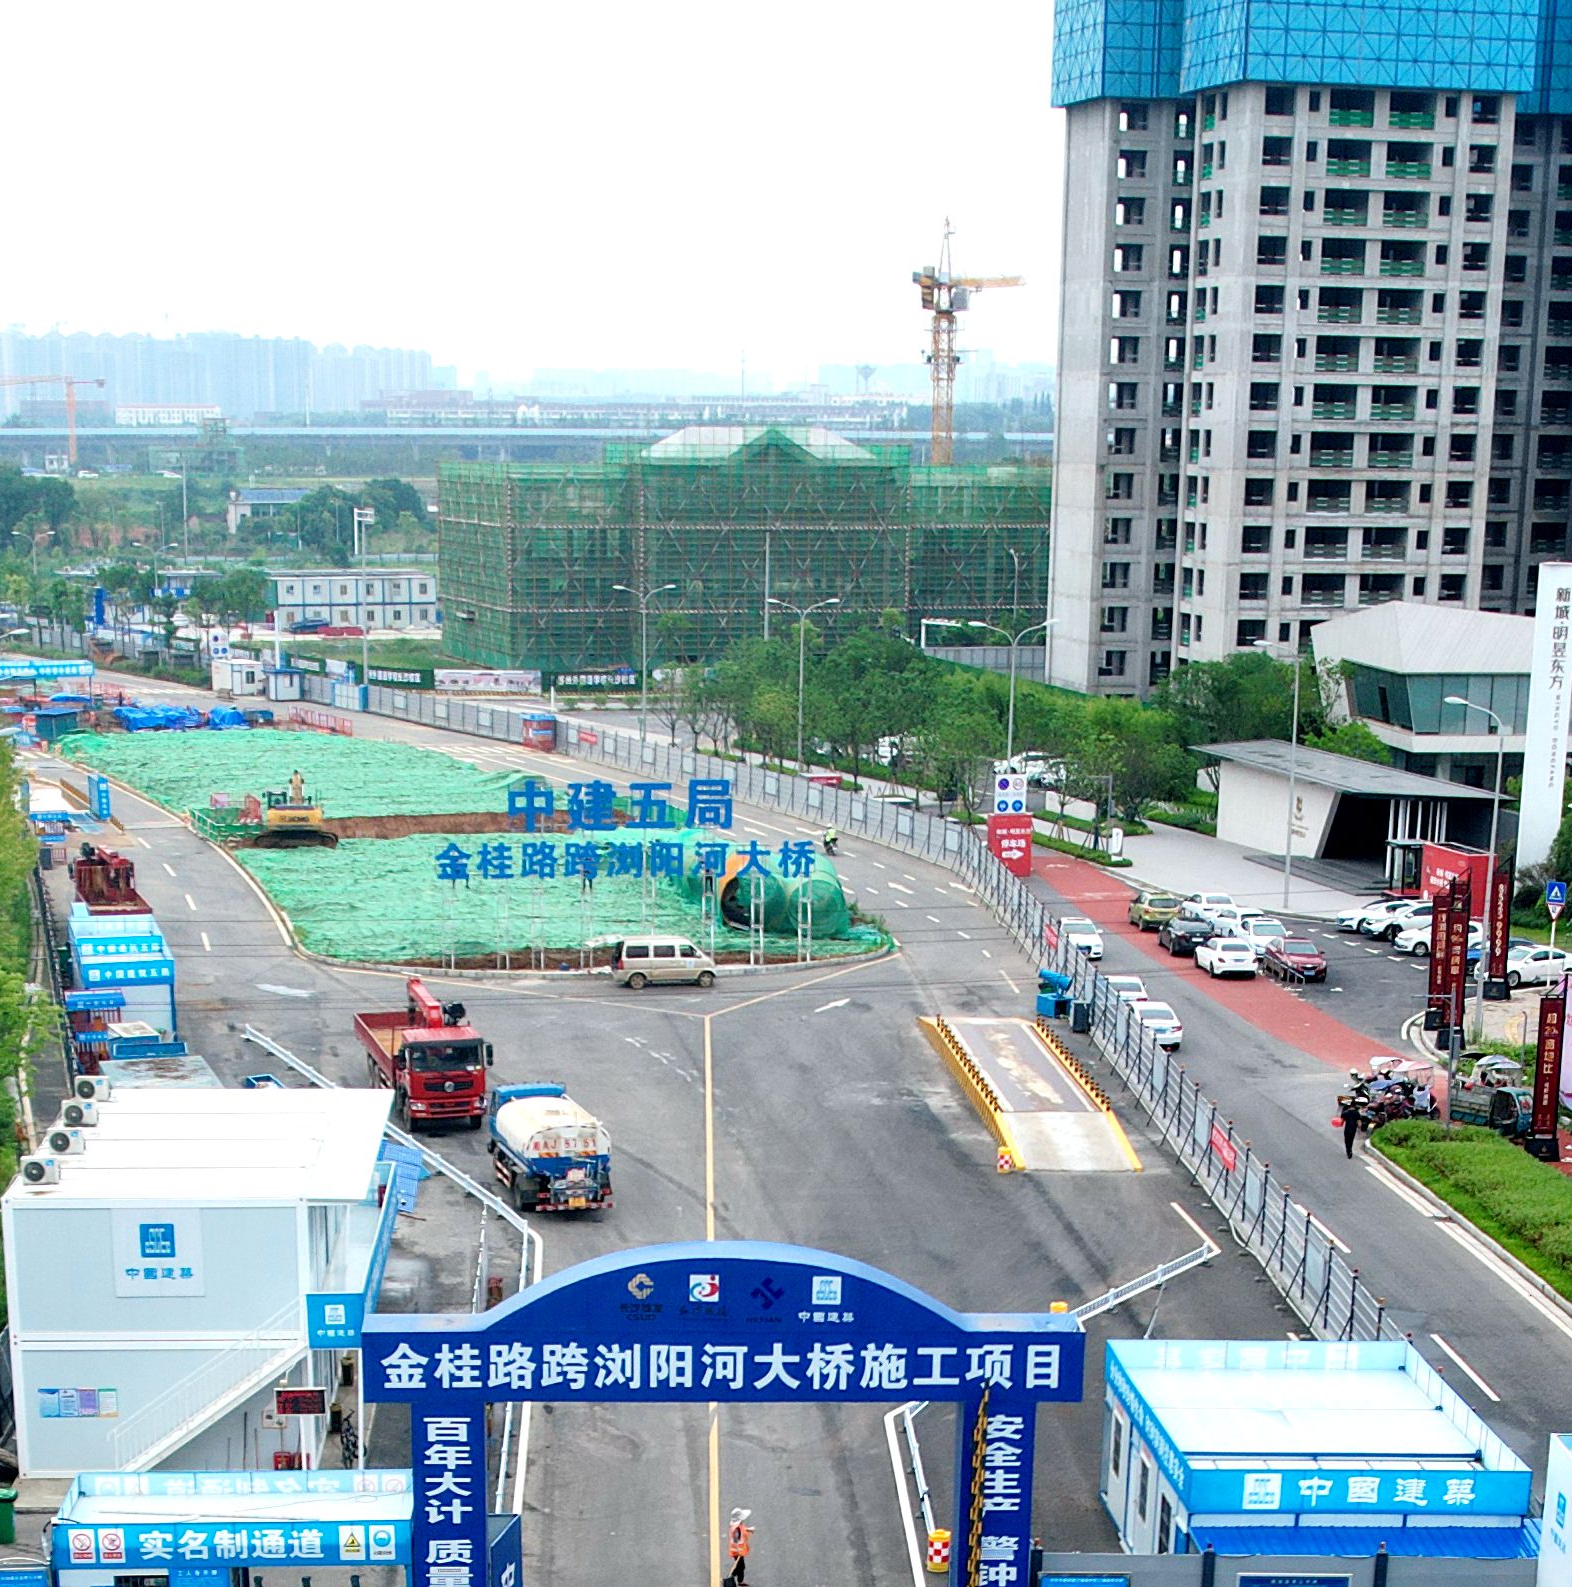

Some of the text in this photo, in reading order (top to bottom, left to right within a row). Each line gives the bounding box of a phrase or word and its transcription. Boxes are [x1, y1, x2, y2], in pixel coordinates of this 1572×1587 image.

[508, 778, 732, 832] 中建五局
[435, 839, 816, 880] 金桂路跨浏阳河大桥
[379, 1341, 1062, 1391] 金桂路跨浏阳河大桥施工项目
[423, 1416, 474, 1526] 百年大计
[981, 1414, 1024, 1517] 安全生产
[138, 1528, 325, 1562] 实名制通道
